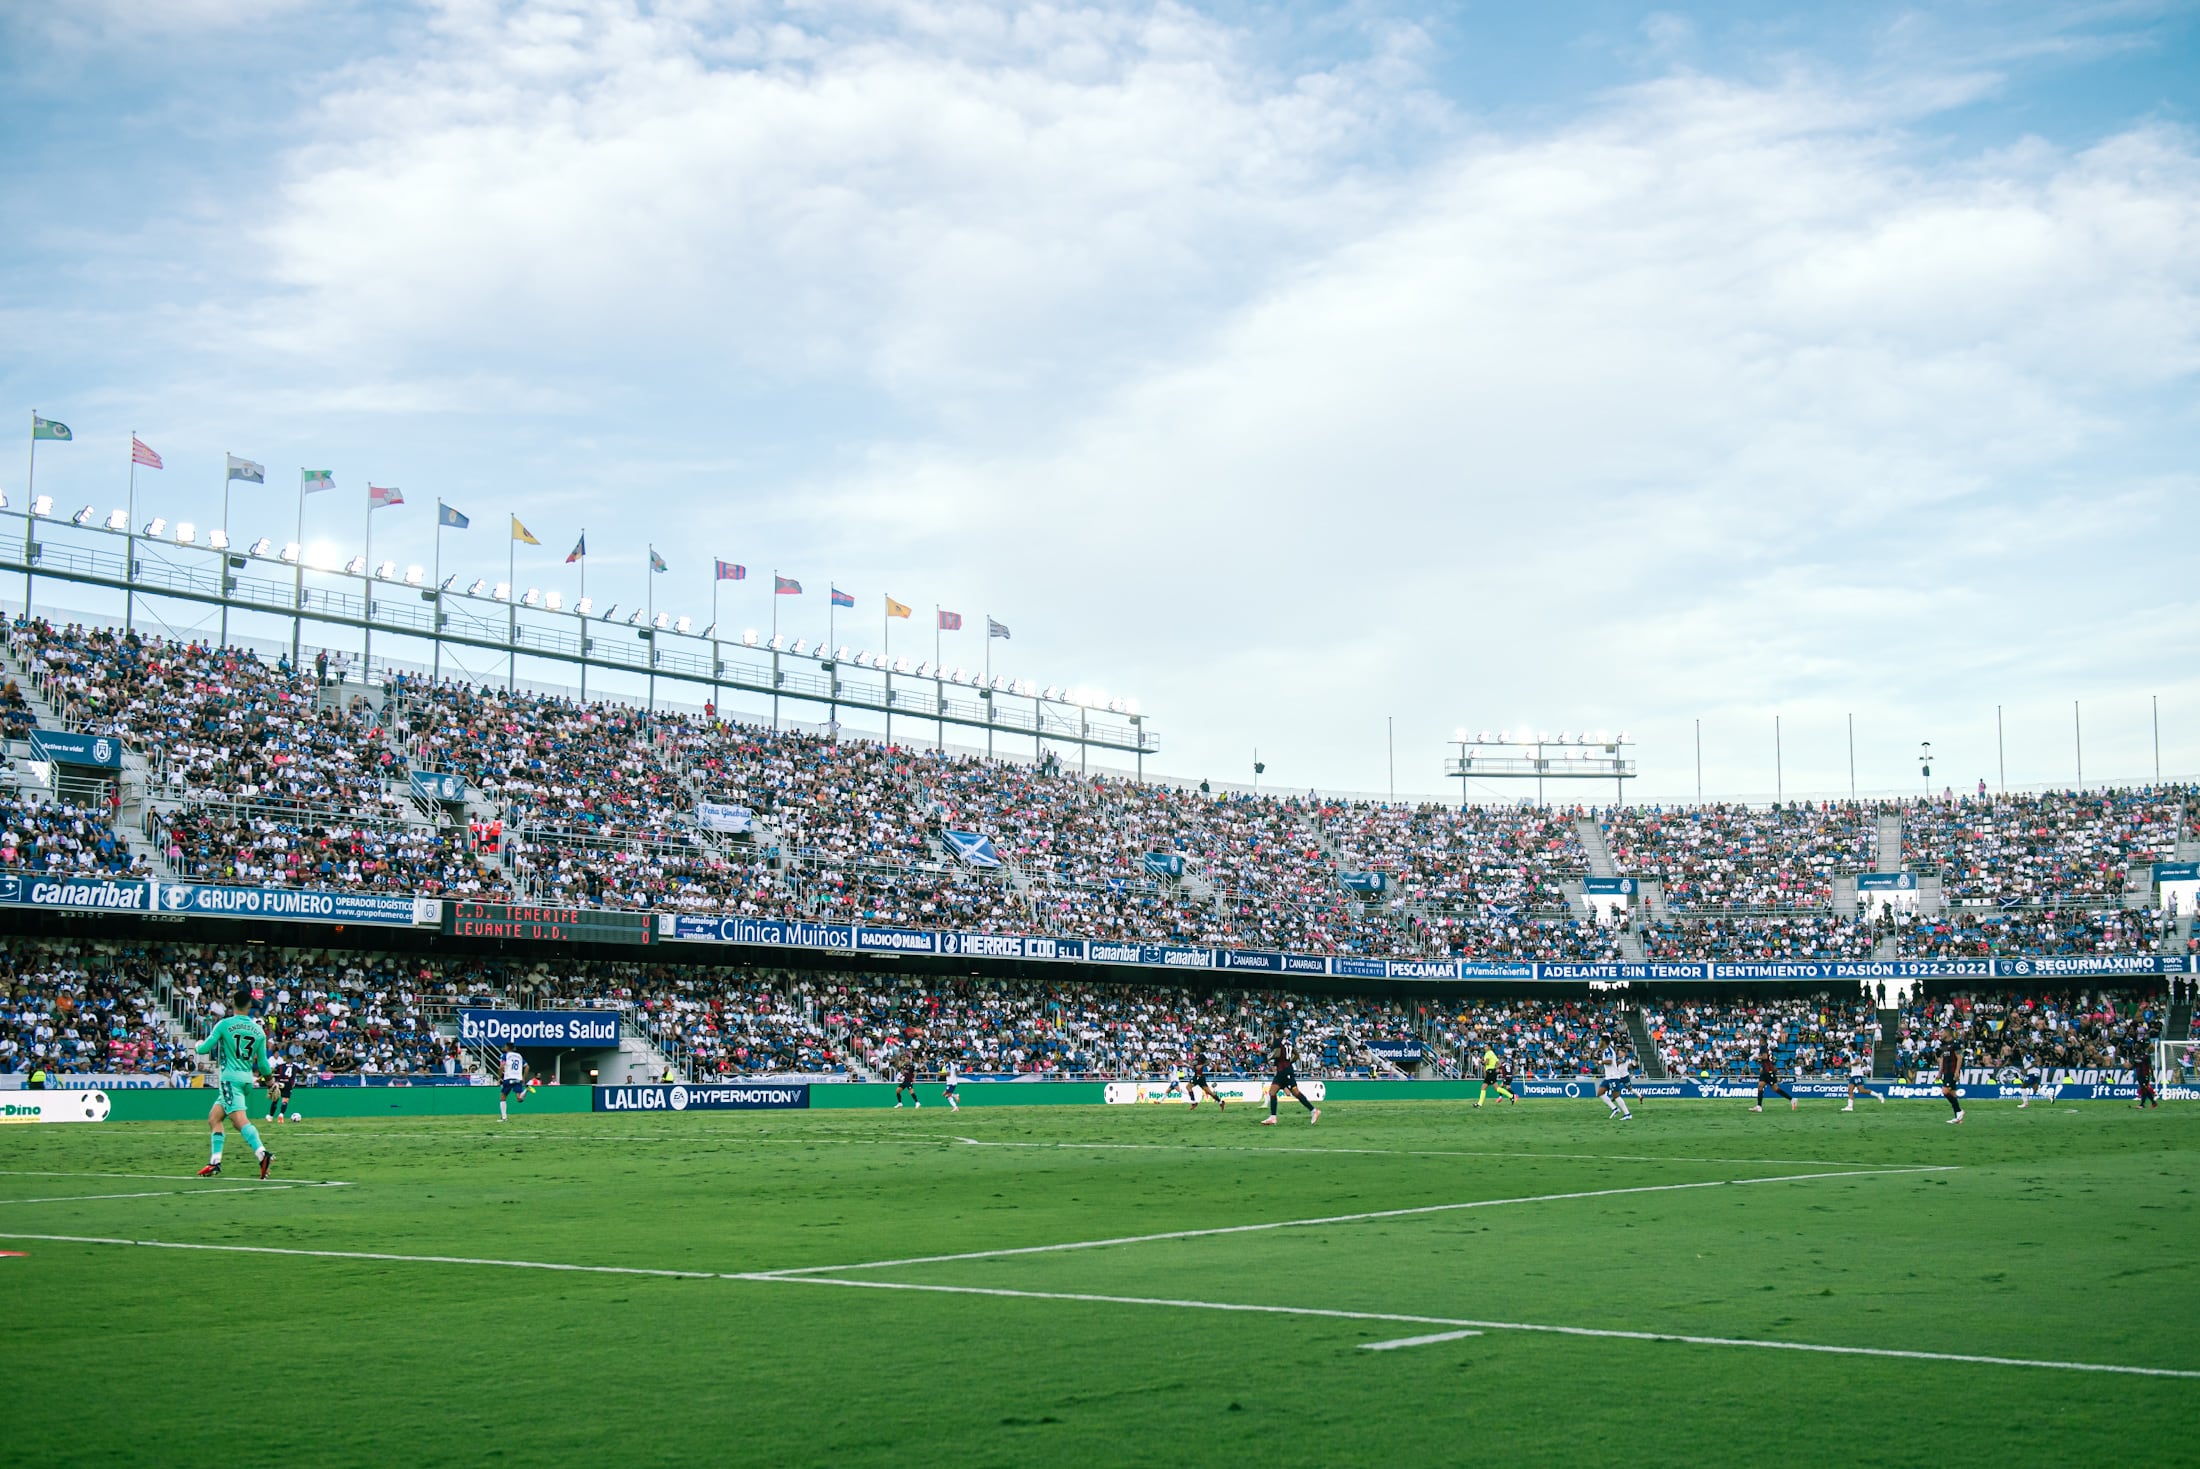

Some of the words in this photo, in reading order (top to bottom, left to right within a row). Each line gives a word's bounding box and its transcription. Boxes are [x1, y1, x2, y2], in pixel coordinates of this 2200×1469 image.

[31, 880, 145, 909] canaribat
[198, 890, 260, 911] GRUPO
[263, 893, 333, 915] FUMERO
[335, 896, 376, 909] OPERADOR
[377, 898, 413, 912] LOGÍSTICO
[335, 907, 413, 921] www.grupofumero.es
[455, 903, 492, 919] C.D.
[506, 906, 579, 924] TENERIFE
[455, 921, 522, 938] LEVANTE
[533, 925, 568, 941] U.D.
[641, 931, 650, 944] 0
[721, 918, 781, 944] Clínica
[786, 924, 848, 948] Muiños
[861, 932, 893, 946] RADIO
[960, 935, 1021, 957] HIERROS
[1024, 939, 1056, 958] ICOD
[1091, 944, 1140, 963] canaribat
[1164, 948, 1210, 967] canaribat
[1232, 955, 1270, 968] CANARAGUA
[1289, 958, 1323, 971] CANARAGUA
[1391, 963, 1456, 977] PESCAMAR
[1544, 966, 1617, 977] ADELANTE
[1621, 966, 1646, 977] SIN
[1650, 966, 1702, 977] TEMOR
[1716, 965, 1818, 977] SENTIMIENTO
[1821, 965, 1832, 975] Y
[1837, 962, 1894, 976] PASIÓN
[1899, 962, 1987, 975] 1922-2022
[569, 1020, 615, 1039] Salud
[234, 1034, 256, 1061] 13
[1403, 1048, 1421, 1058] Salud
[285, 1067, 292, 1077] 4
[1525, 1084, 1563, 1095] hospiten
[1713, 1085, 1763, 1097] humme
[1792, 1085, 1812, 1093] Islas
[1888, 1085, 1966, 1098] HiperDo
[2162, 1088, 2200, 1100] Binte
[605, 1088, 666, 1109] LALIGA
